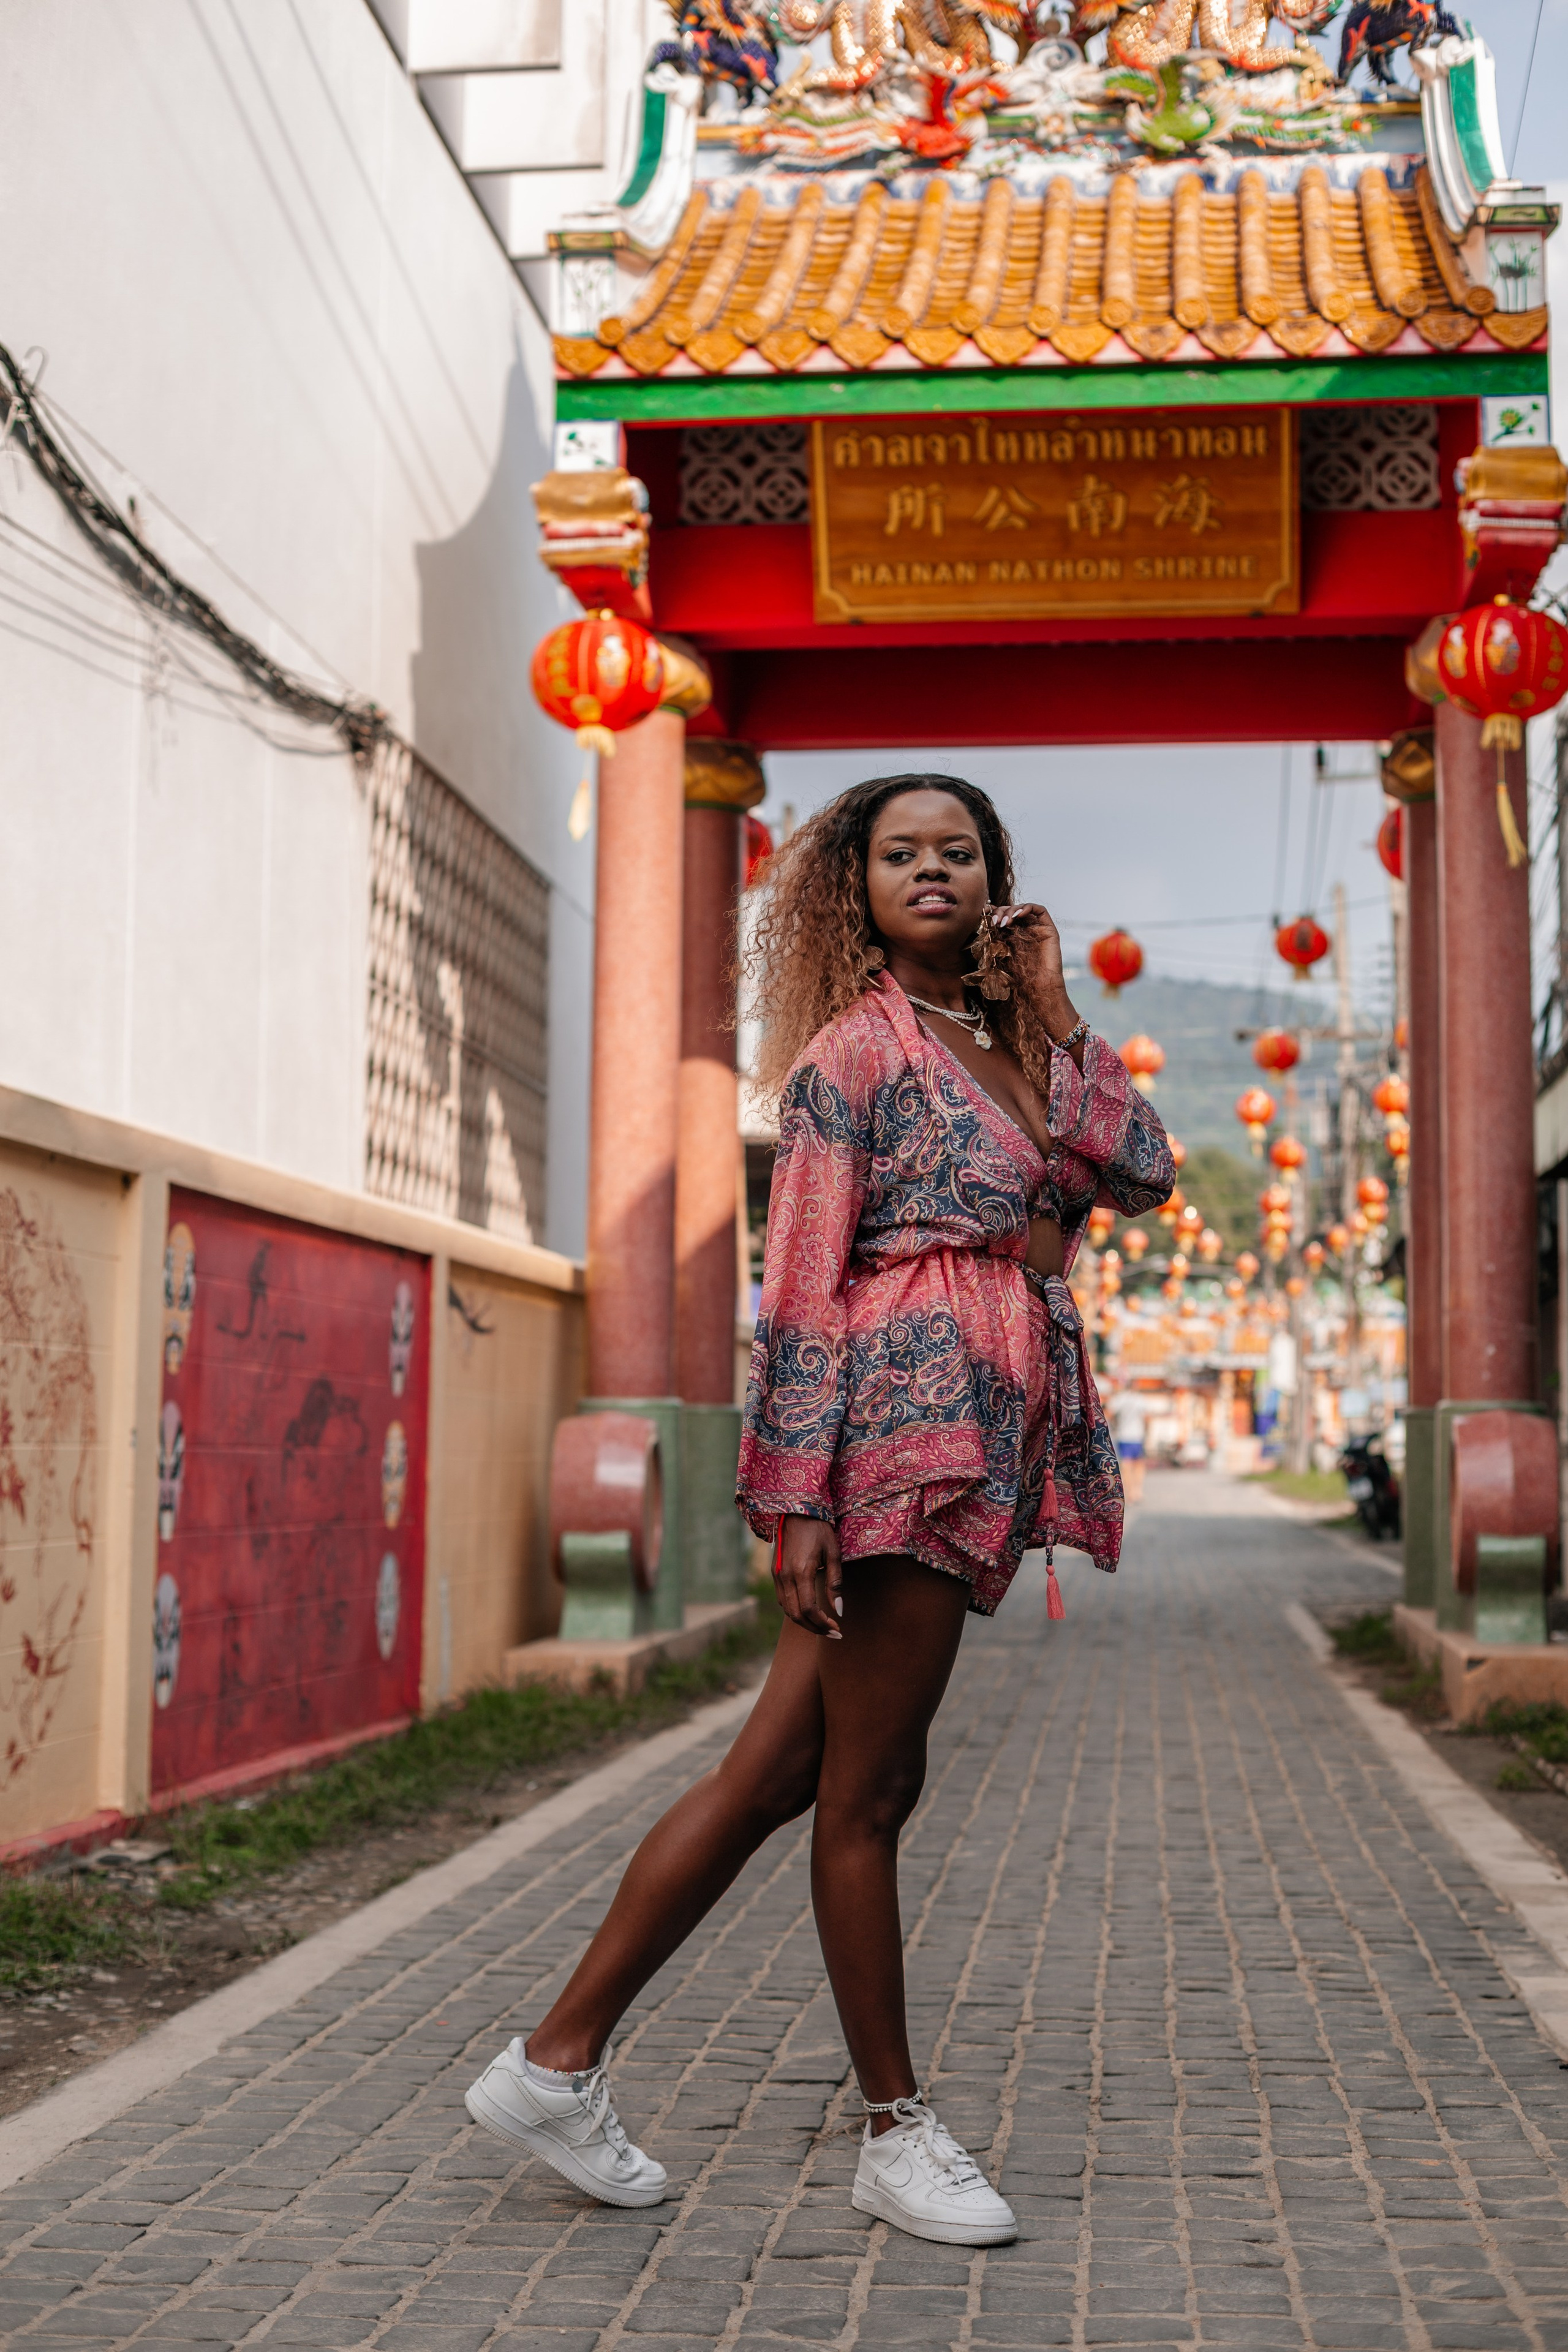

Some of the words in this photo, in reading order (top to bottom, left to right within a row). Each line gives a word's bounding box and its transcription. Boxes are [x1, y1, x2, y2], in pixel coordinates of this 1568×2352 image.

[851, 562, 978, 585] HAINAN
[989, 558, 1122, 582] NATHON
[1133, 556, 1258, 580] SHRINE
